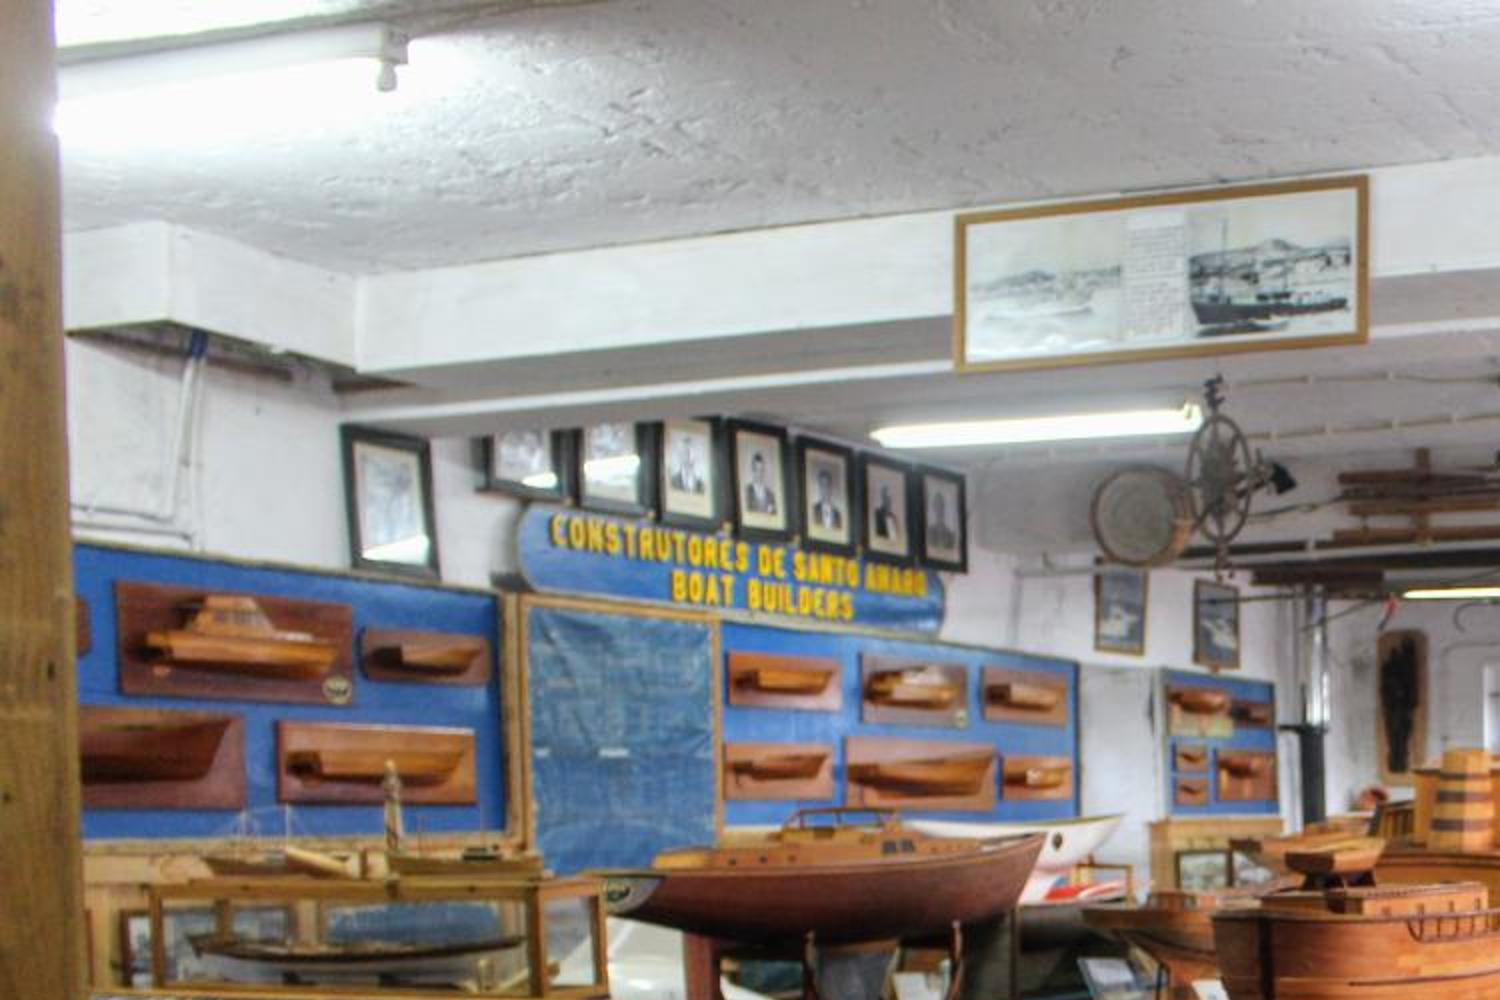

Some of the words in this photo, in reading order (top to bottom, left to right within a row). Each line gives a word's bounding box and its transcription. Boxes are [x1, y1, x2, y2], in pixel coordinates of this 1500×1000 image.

[552, 513, 749, 573] CONSTRUTORES
[758, 544, 786, 579] DE
[793, 550, 859, 588] SANTO
[672, 568, 735, 606] BOAT
[747, 578, 854, 621] BUILDERS
